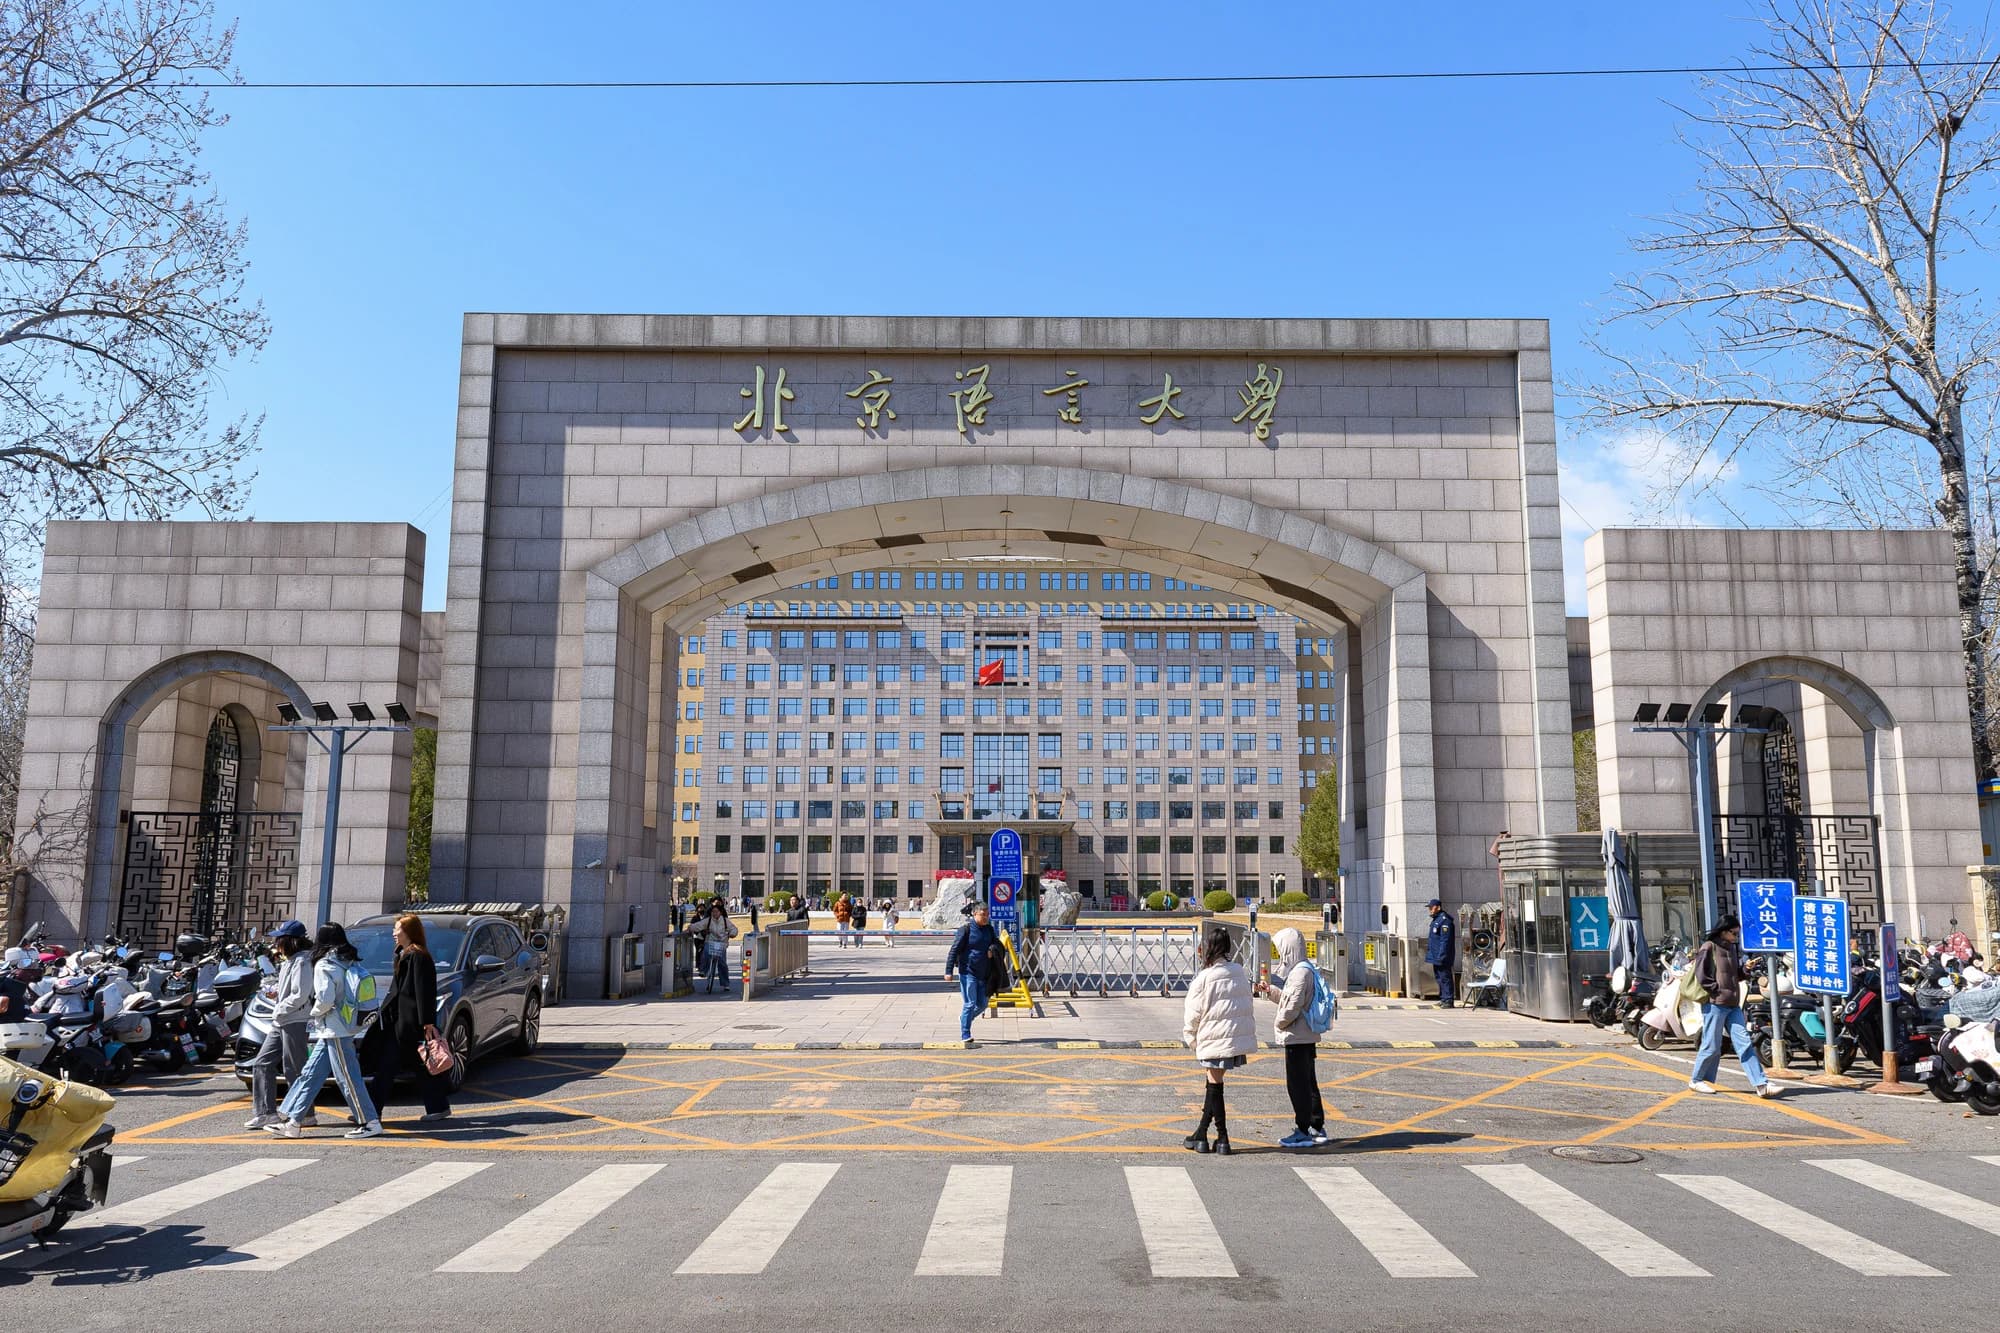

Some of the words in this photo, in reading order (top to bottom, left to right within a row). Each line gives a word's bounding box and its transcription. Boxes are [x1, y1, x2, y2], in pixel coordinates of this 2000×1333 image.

[1577, 902, 1599, 948] 入口
[1756, 884, 1778, 948] 行人出入口
[1802, 902, 1819, 972] 请您出示证件
[1821, 903, 1839, 974] 配合门卫查证
[1801, 974, 1844, 989] 谢谢合作
